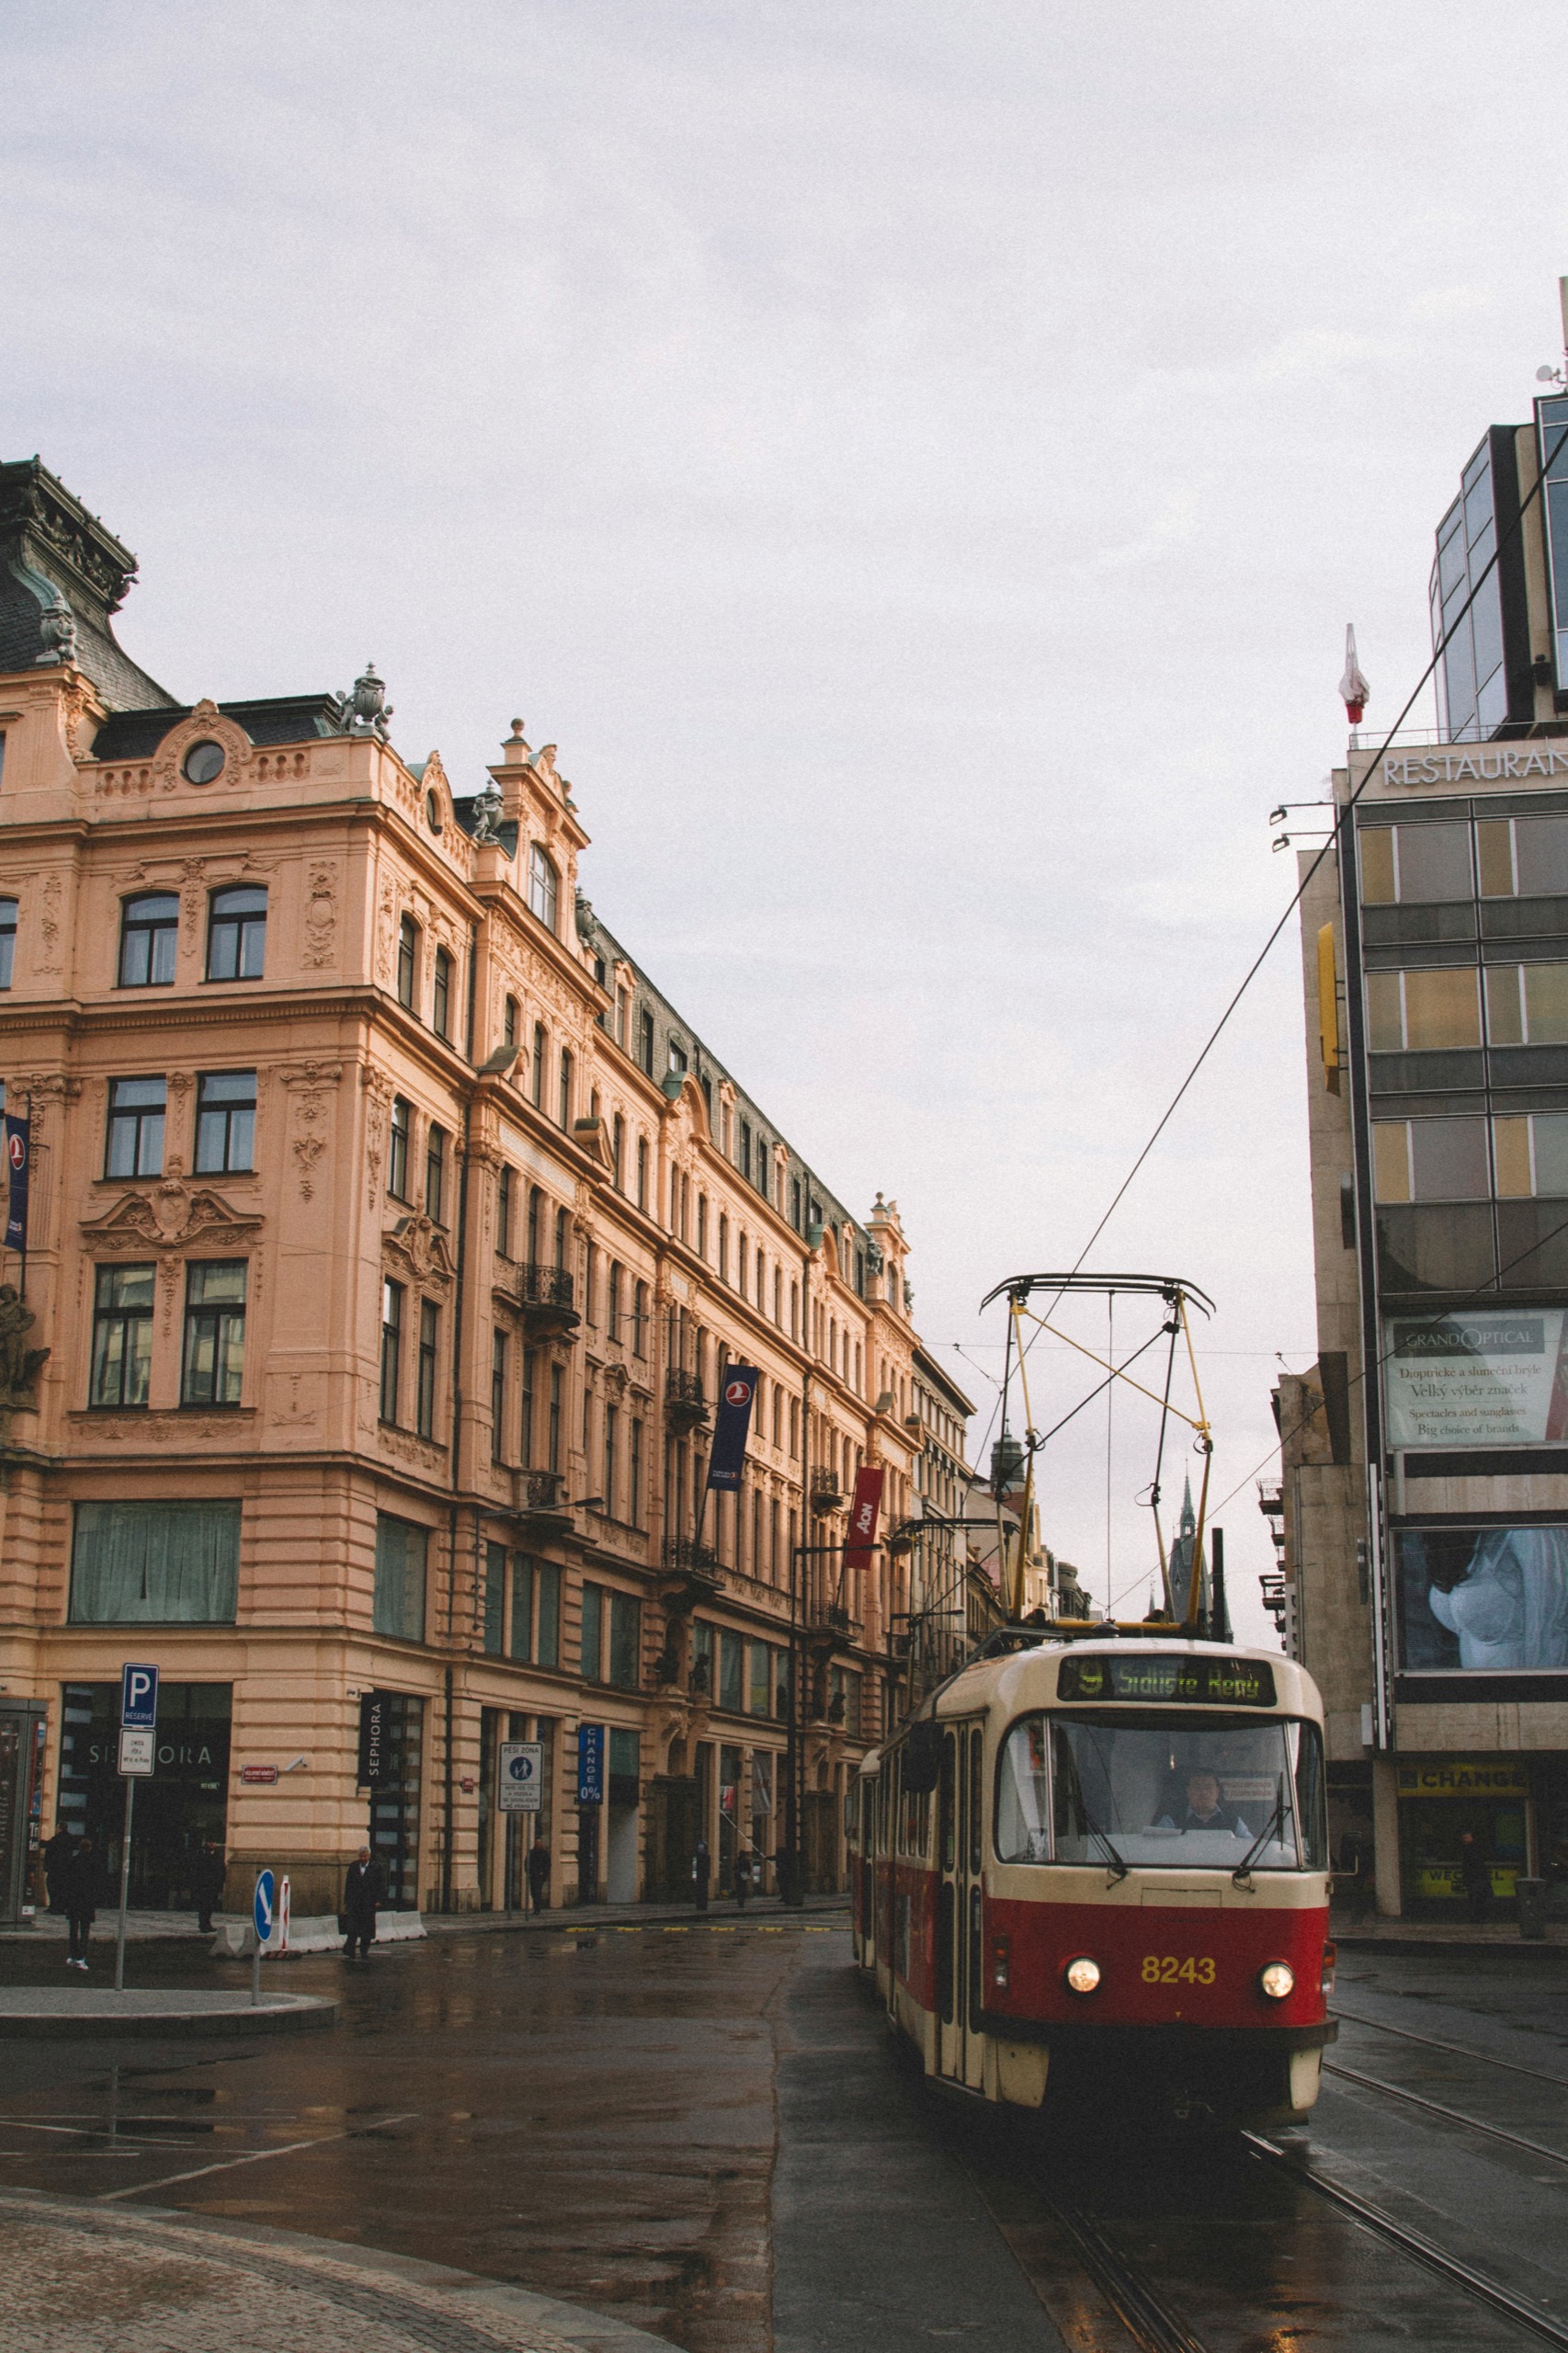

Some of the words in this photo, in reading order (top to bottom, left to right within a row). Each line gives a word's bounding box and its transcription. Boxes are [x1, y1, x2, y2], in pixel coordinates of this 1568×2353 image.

[1400, 1367, 1456, 1381] Dioptrické
[1468, 1366, 1512, 1377] sluneční
[1515, 1364, 1541, 1378] brýle
[1411, 1383, 1448, 1400] Velký
[1451, 1384, 1484, 1400] výběr
[1487, 1382, 1528, 1396] značek
[1409, 1408, 1457, 1420] Spectacles
[1460, 1408, 1477, 1417] and
[1479, 1406, 1527, 1418] sunglasses
[1417, 1424, 1437, 1437] Big
[1439, 1424, 1471, 1435] choice
[1472, 1424, 1483, 1434] of
[1486, 1423, 1519, 1433] brands
[1078, 1659, 1103, 1694] 9
[130, 1672, 151, 1708] P
[369, 1704, 381, 1776] SEPHORA
[586, 1728, 596, 1783] CHANGE
[1422, 1770, 1527, 1788] CHANGE
[581, 1787, 600, 1800] 0%
[1141, 1955, 1216, 1984] 8243
